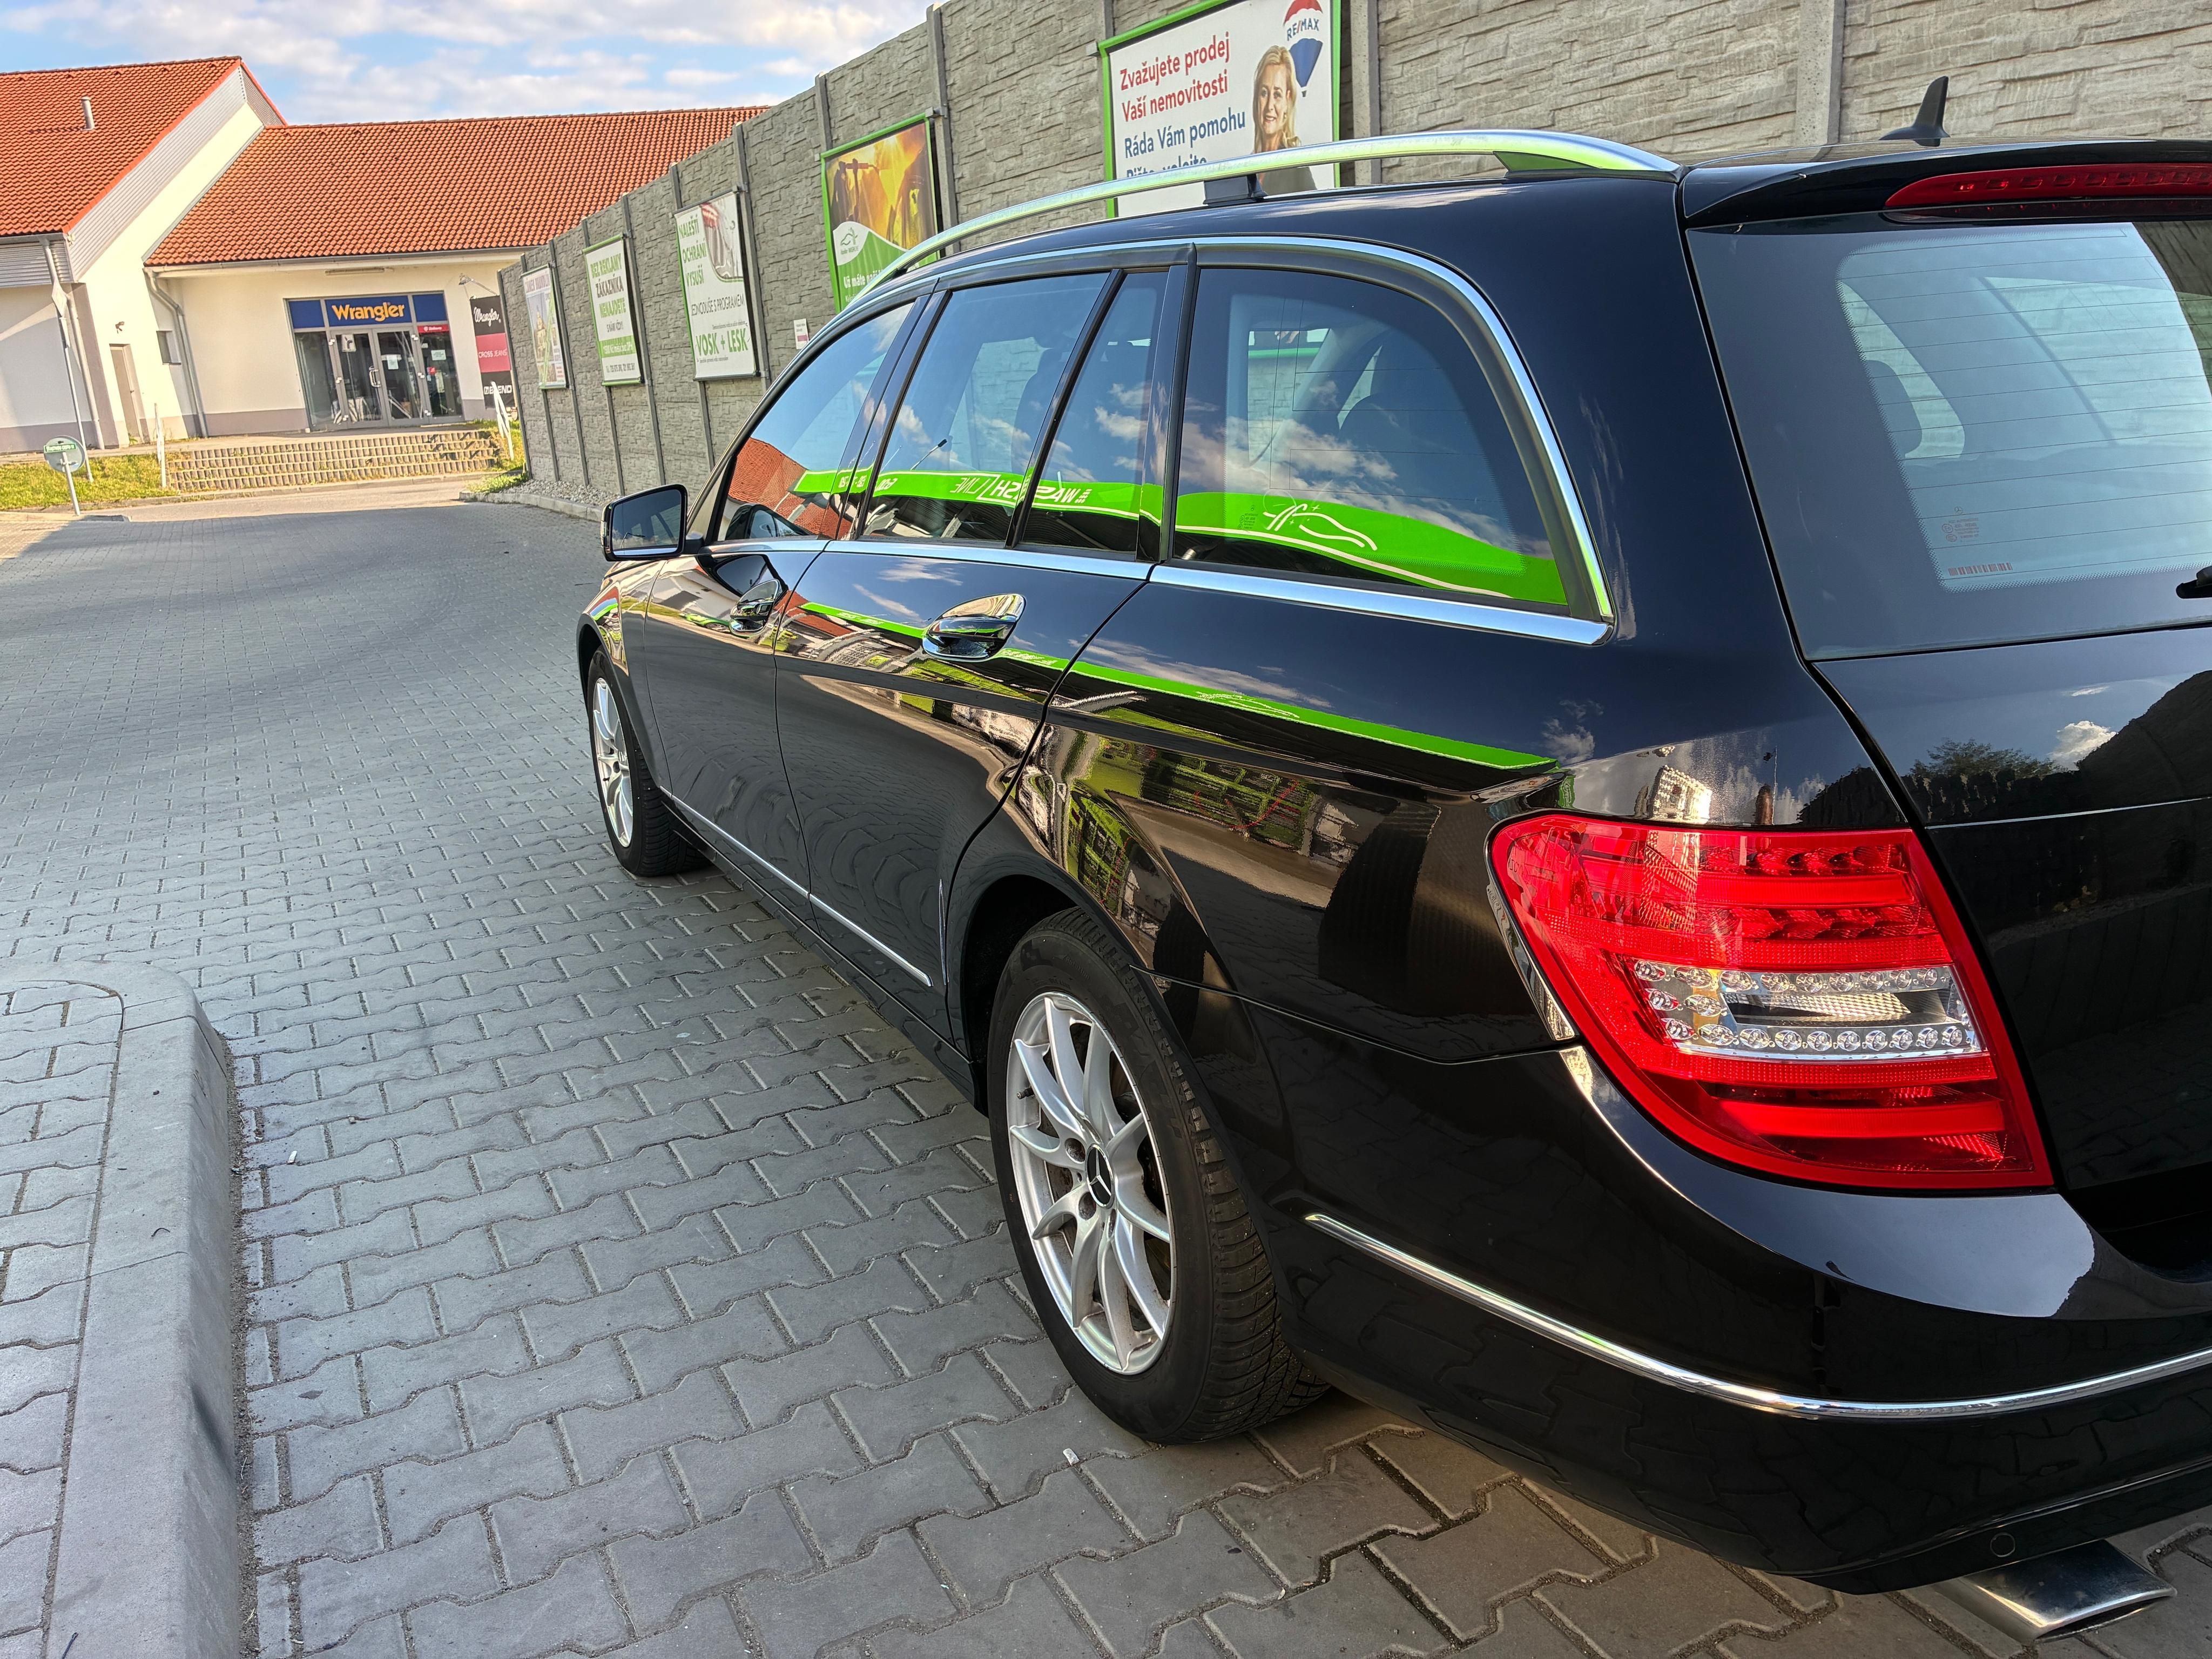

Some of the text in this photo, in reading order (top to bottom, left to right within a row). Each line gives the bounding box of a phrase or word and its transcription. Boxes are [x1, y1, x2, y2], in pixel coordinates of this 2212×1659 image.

[1286, 18, 1320, 41] RE/MAX
[1120, 31, 1230, 91] Zvažujete prodej
[1121, 69, 1228, 122] Vaší nemovitosti
[1124, 107, 1246, 158] Ráda Vám pomohu
[678, 214, 699, 239] NALEŠTÍ
[682, 238, 707, 264] OCHRÁNÍ
[331, 302, 404, 322] Wrangler
[478, 350, 493, 359] CROSS
[696, 332, 720, 356] VOSK
[727, 328, 748, 353] LESK
[489, 385, 512, 395] BEND
